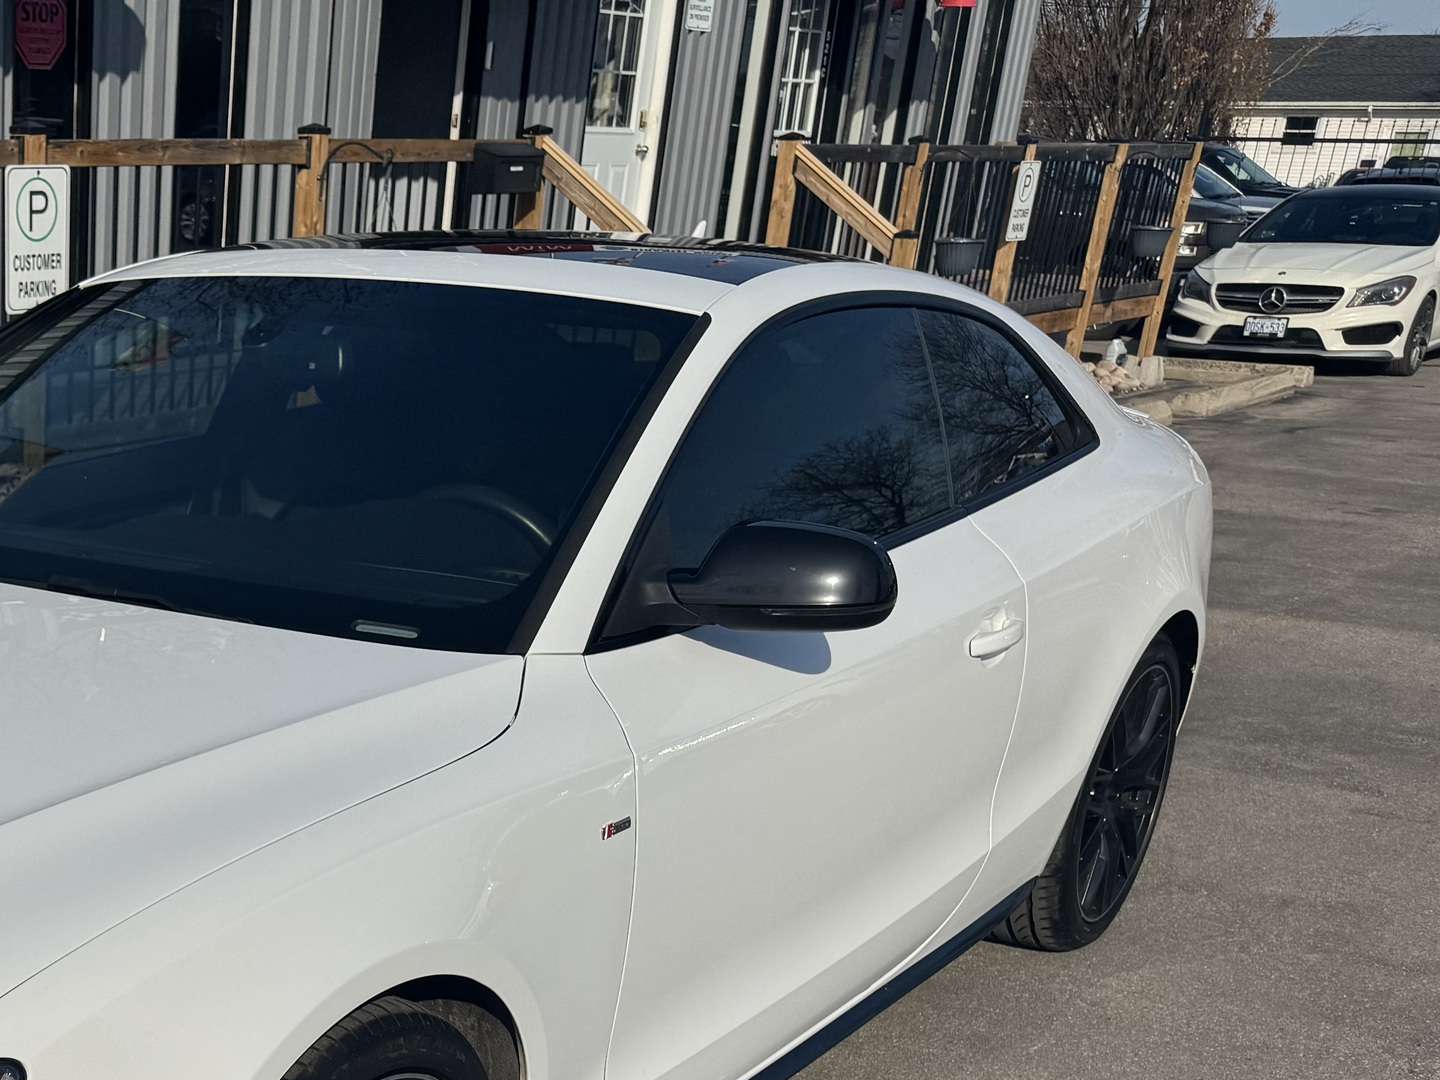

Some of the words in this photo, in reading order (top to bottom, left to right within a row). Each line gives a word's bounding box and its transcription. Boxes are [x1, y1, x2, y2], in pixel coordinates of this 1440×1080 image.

[21, 2, 59, 23] STOP
[29, 190, 48, 232] P
[13, 253, 62, 271] CUSTOMER
[18, 280, 56, 298] PARKING
